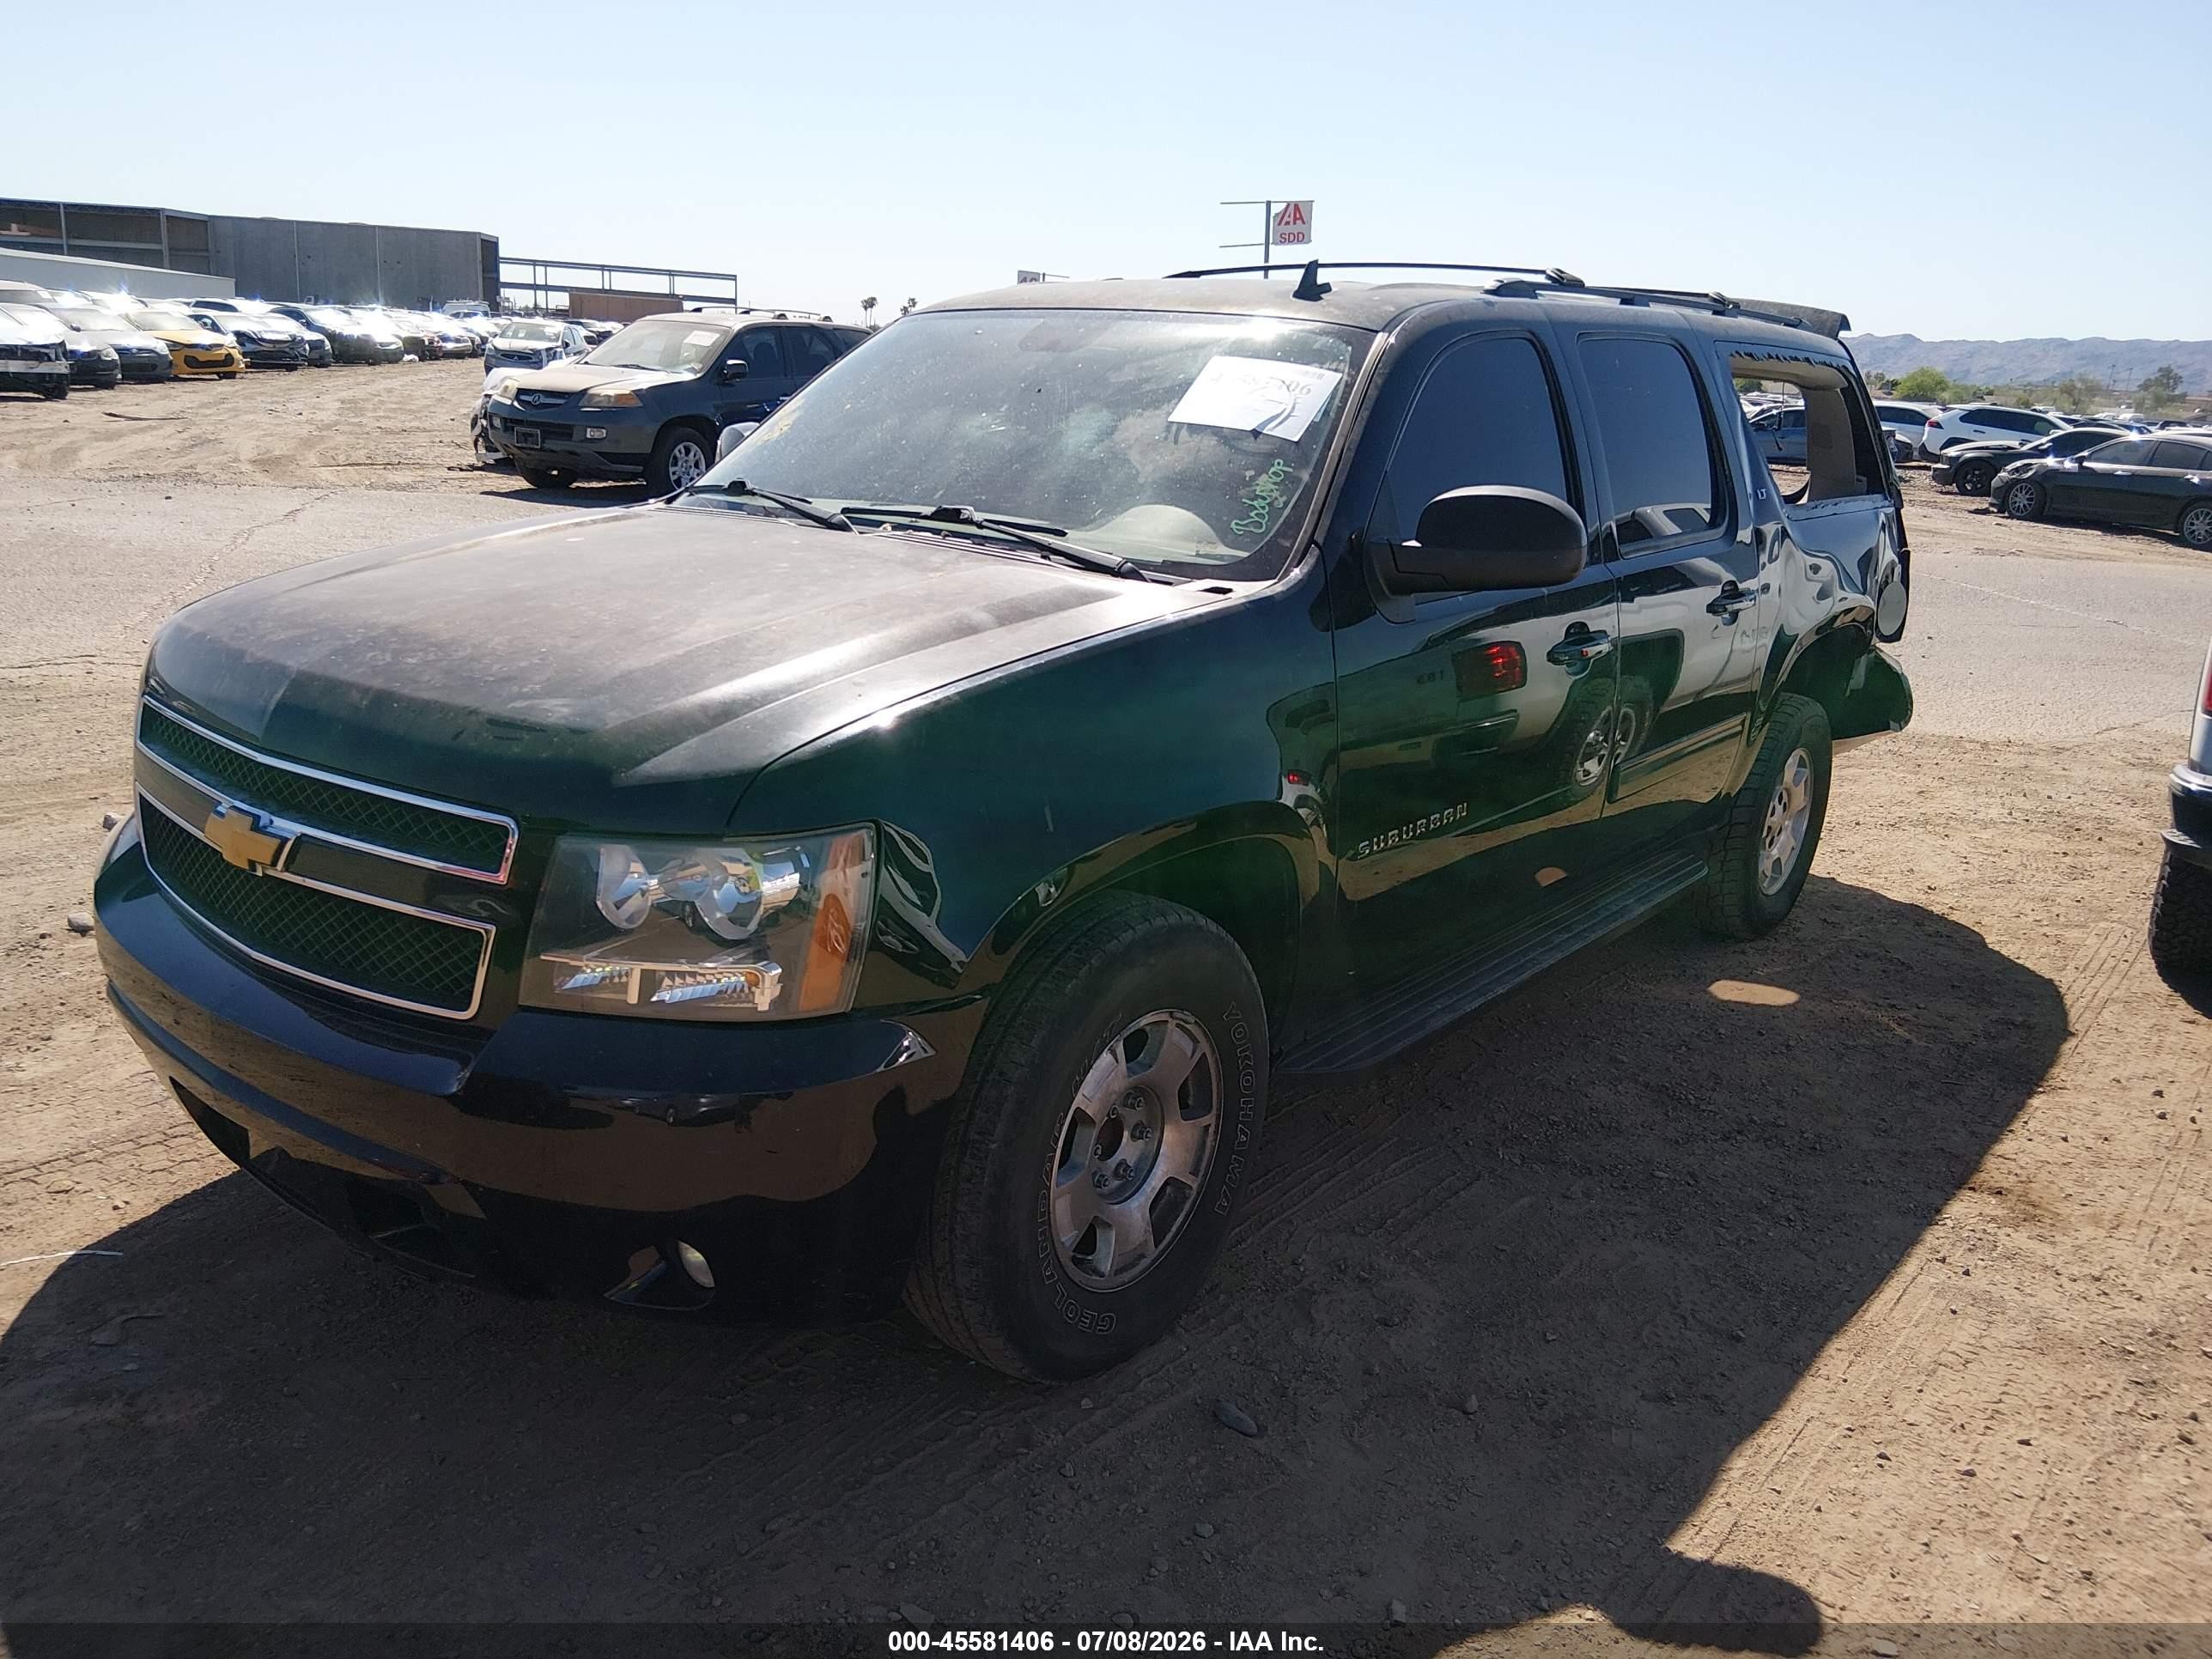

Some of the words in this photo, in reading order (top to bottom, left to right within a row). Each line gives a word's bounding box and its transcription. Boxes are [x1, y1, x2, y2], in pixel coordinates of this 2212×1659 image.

[1279, 232, 1305, 244] SDD
[1357, 802, 1468, 860] SUBURBAN
[1213, 1001, 1256, 1217] YOKOHAMA
[1036, 1112, 1117, 1335] GEOLANDAR
